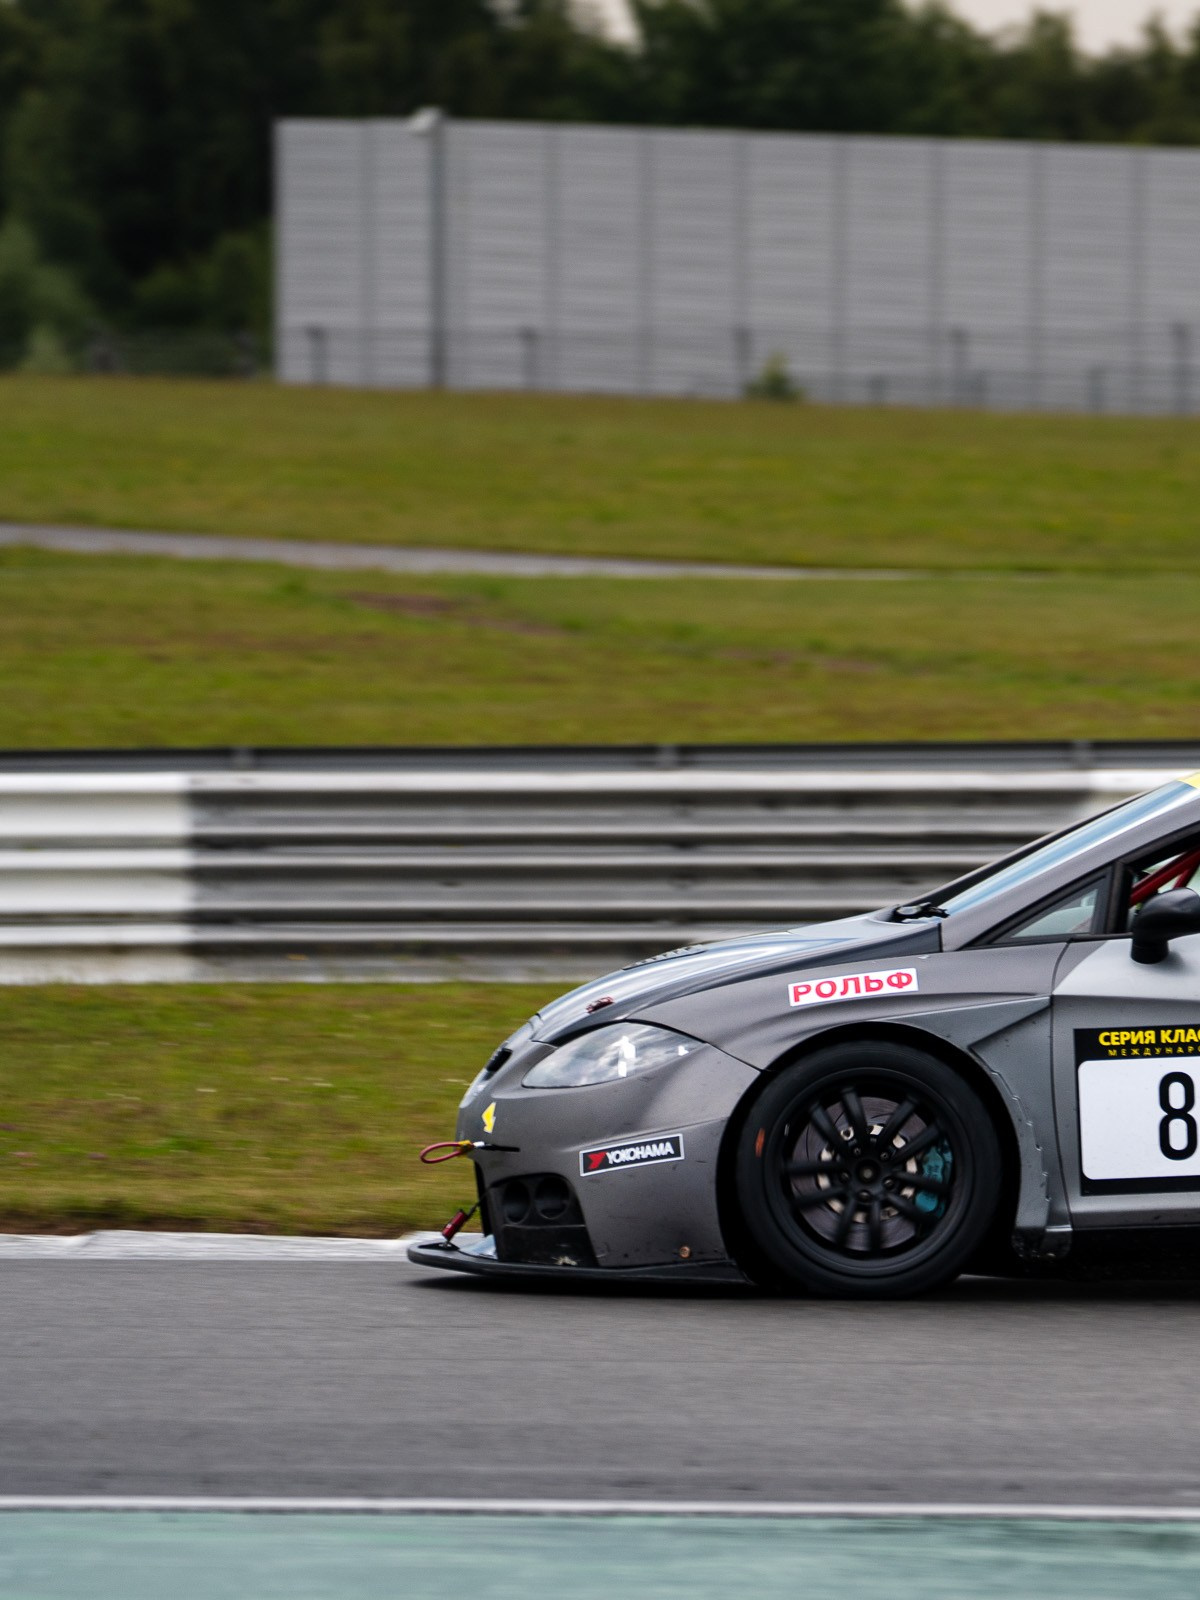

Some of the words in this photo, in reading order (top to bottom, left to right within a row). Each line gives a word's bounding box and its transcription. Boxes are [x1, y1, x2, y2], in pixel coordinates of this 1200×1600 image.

[793, 972, 913, 1002] РОЛЬФ
[1098, 1030, 1156, 1046] СЕРИЯ
[1159, 1071, 1198, 1161] 8
[605, 1141, 675, 1165] YOKOHAMA
